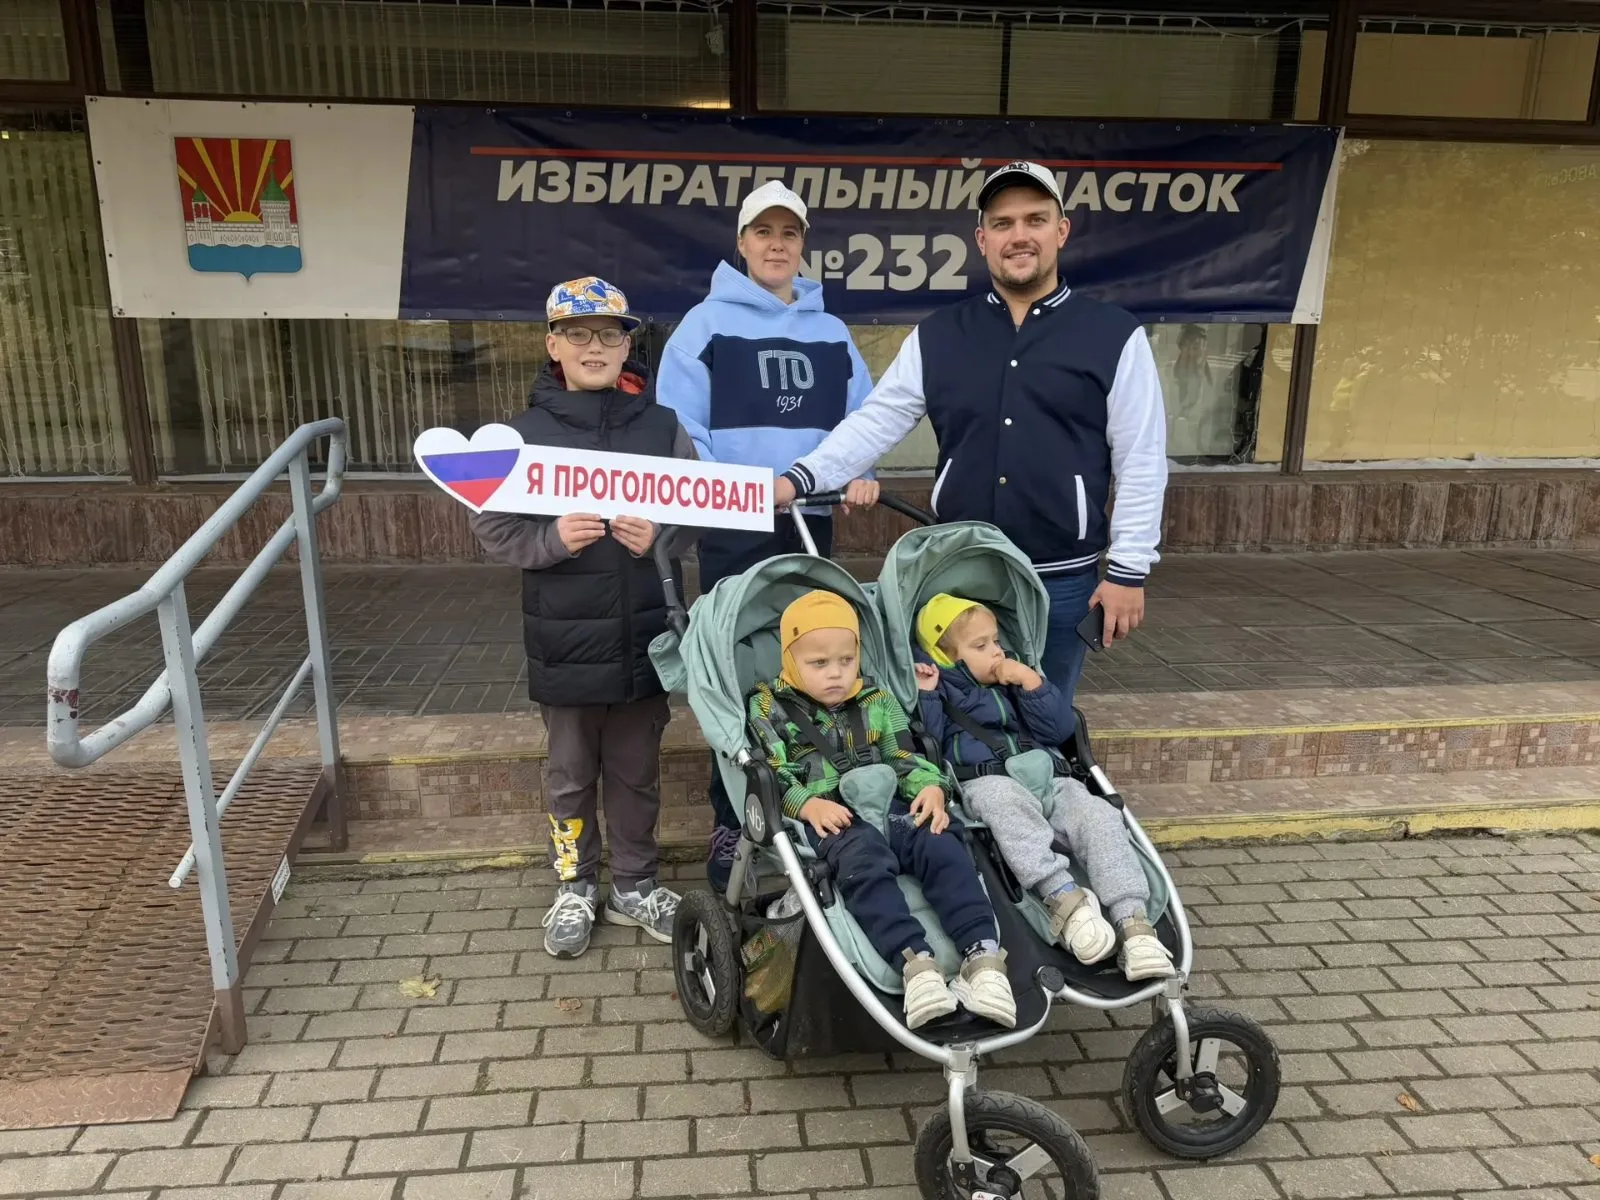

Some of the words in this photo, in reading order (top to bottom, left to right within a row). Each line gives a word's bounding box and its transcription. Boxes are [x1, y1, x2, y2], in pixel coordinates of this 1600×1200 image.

[1056, 171, 1246, 214] АСТОК
[799, 233, 968, 291] №232
[757, 350, 815, 390] ГТО
[776, 395, 803, 414] 1931
[526, 463, 544, 495] Я
[554, 464, 765, 513] ПРОГОЛОСОВАЛ!
